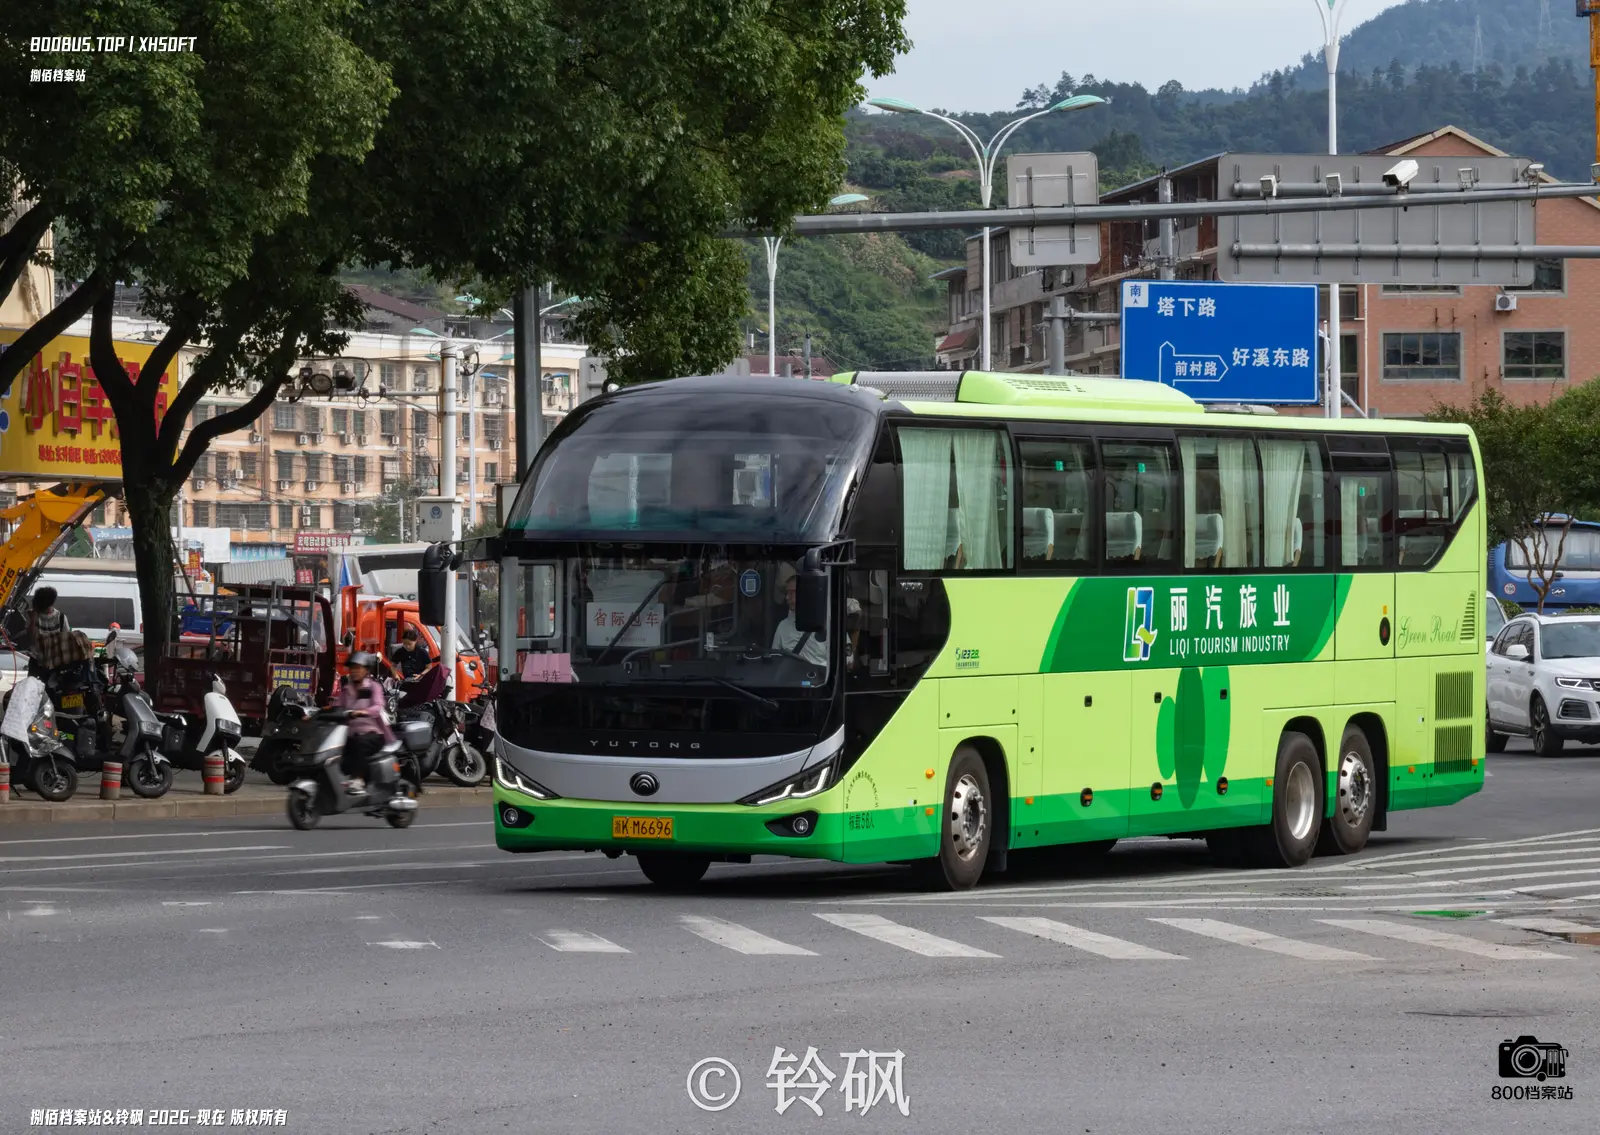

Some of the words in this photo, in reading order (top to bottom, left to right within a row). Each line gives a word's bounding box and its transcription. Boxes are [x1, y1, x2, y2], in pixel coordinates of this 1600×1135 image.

[1129, 284, 1142, 297] 南
[1157, 297, 1217, 317] 塔下路
[1232, 347, 1310, 367] 好溪东路
[1174, 361, 1218, 377] 前村路
[1169, 584, 1291, 632] 丽汽旅业
[1398, 615, 1427, 650] Green
[1430, 614, 1459, 643] Road
[1169, 637, 1190, 658] LIQI
[1194, 636, 1238, 655] TOURISM
[1242, 634, 1290, 653] INDUSTRY
[589, 740, 700, 749] YUTONG
